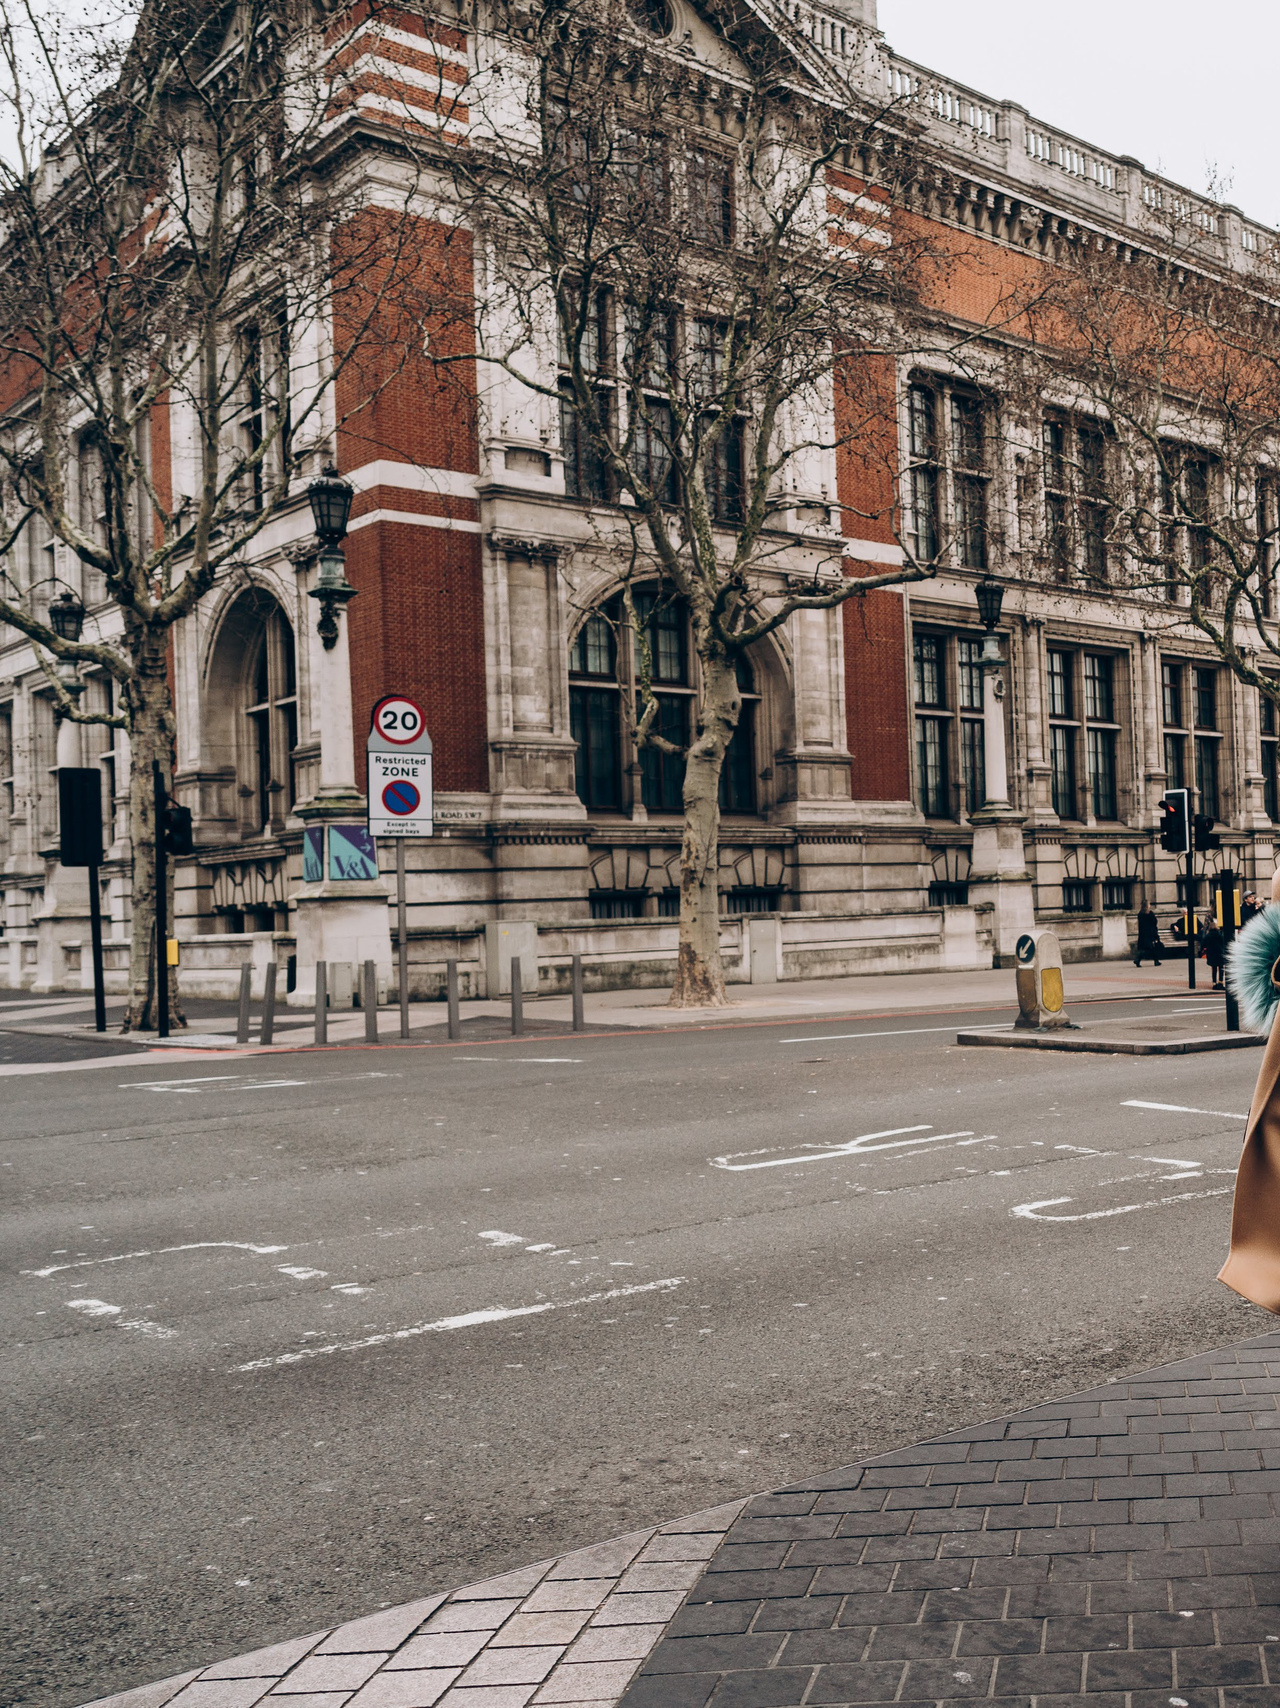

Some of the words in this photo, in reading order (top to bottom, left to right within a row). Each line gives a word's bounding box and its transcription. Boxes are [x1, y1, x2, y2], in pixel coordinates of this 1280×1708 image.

[382, 711, 418, 730] 20
[375, 756, 426, 765] Restricted
[382, 767, 419, 777] ZONE
[441, 811, 462, 819] ROAD
[333, 855, 373, 878] V&A
